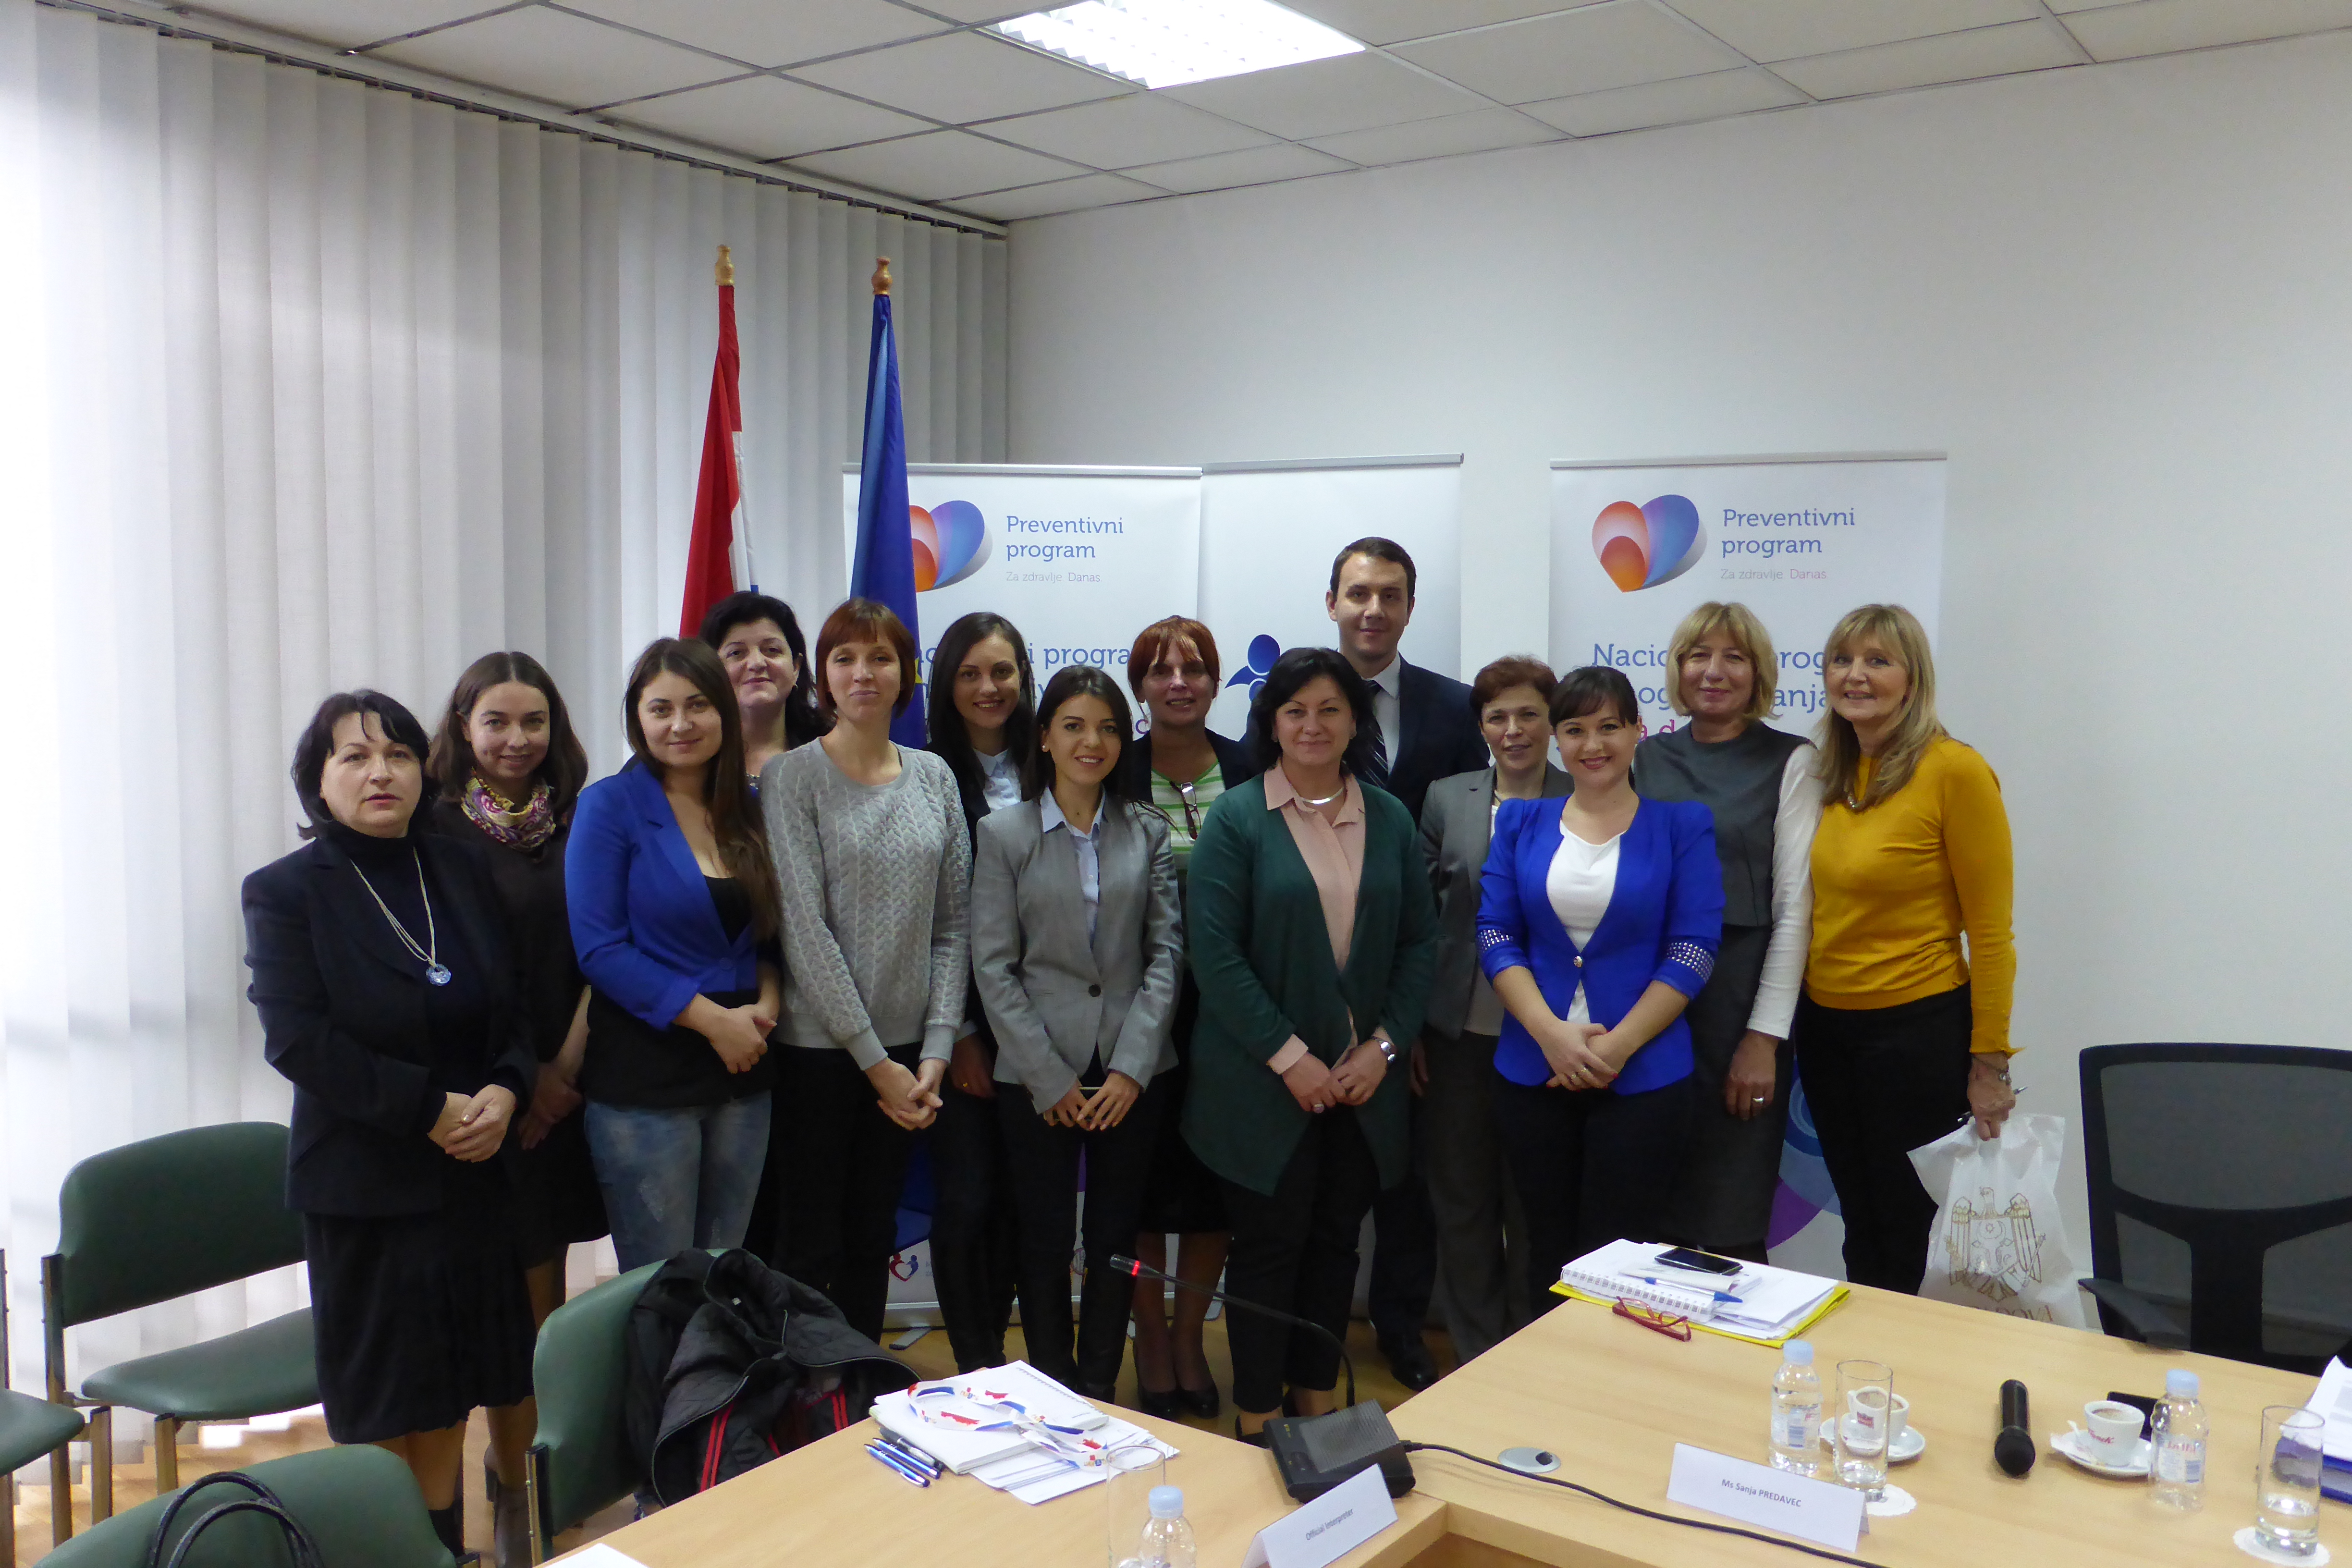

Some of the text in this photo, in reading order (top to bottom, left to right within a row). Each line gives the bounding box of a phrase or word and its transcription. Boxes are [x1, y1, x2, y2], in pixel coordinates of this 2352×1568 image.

[1006, 515, 1124, 534] Preventivni
[1723, 507, 1855, 527] Preventivni
[1006, 545, 1096, 562] program
[1721, 539, 1822, 558] program
[1006, 571, 1019, 582] Za
[1720, 569, 1735, 579] Za
[1043, 648, 1130, 670] progra
[1722, 1479, 1801, 1507] Ms Sanja PREDAVEC
